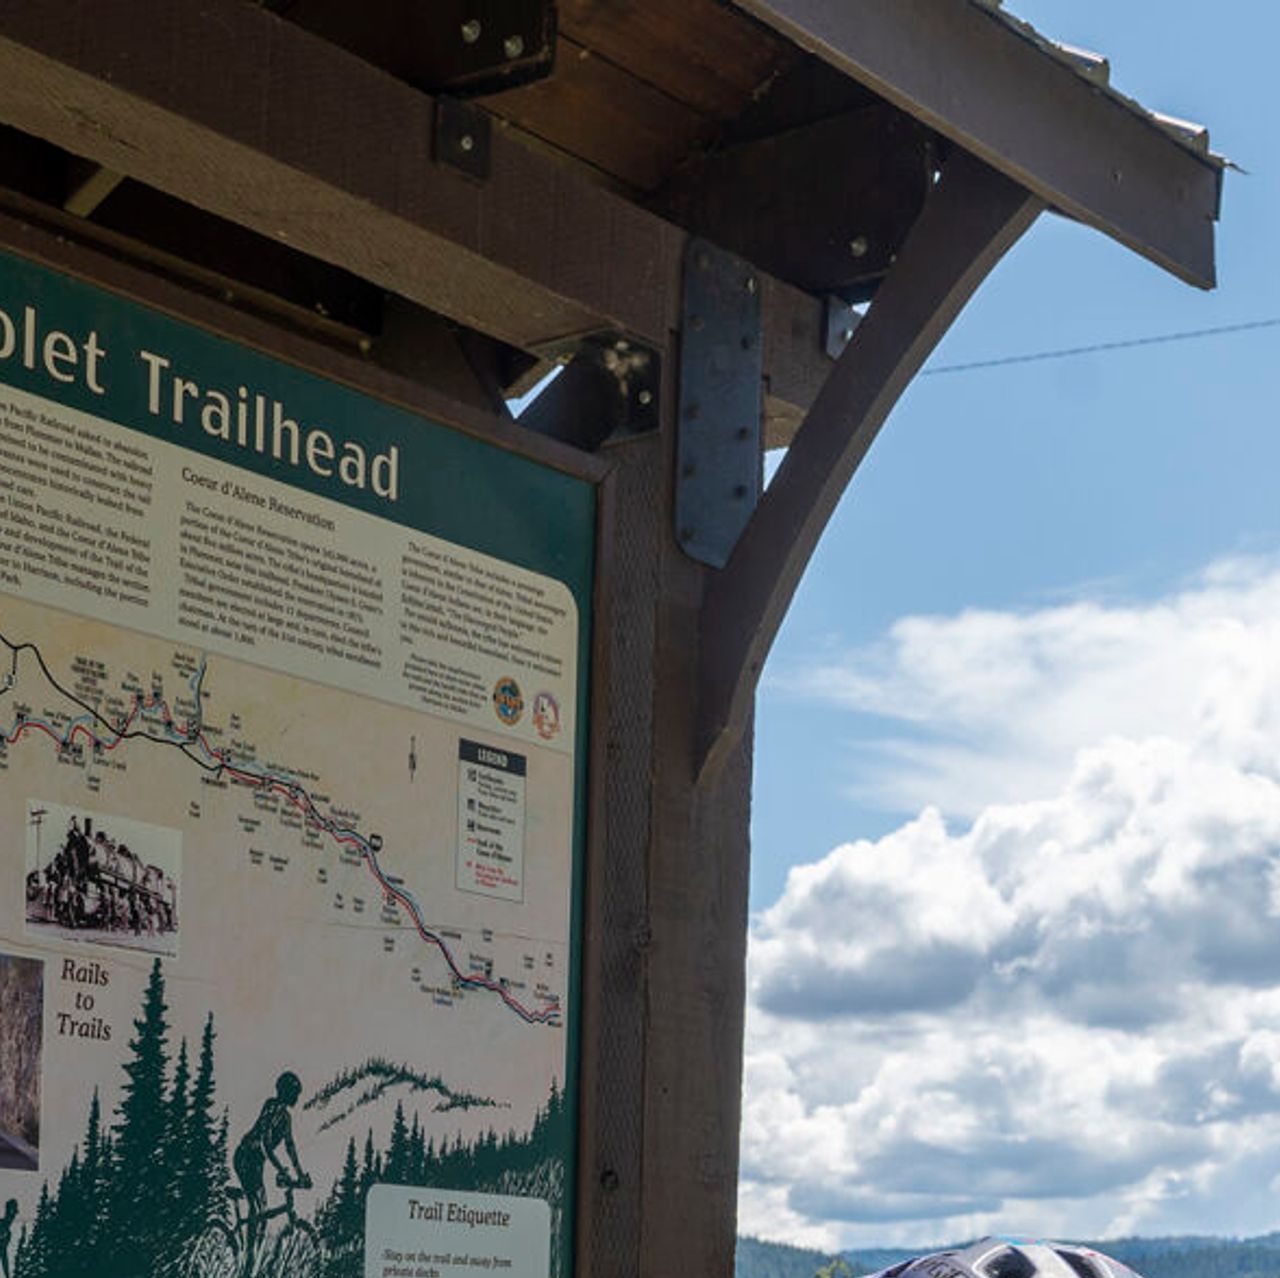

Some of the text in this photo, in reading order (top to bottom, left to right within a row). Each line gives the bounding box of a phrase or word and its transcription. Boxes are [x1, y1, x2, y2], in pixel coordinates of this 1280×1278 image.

[140, 348, 401, 503] Trailhead
[181, 467, 335, 531] Coeur d'Alene Reservation
[60, 959, 110, 987] Rails
[74, 993, 95, 1011] to
[57, 1014, 112, 1042] Trails
[407, 1199, 510, 1227] Trail Etiquette
